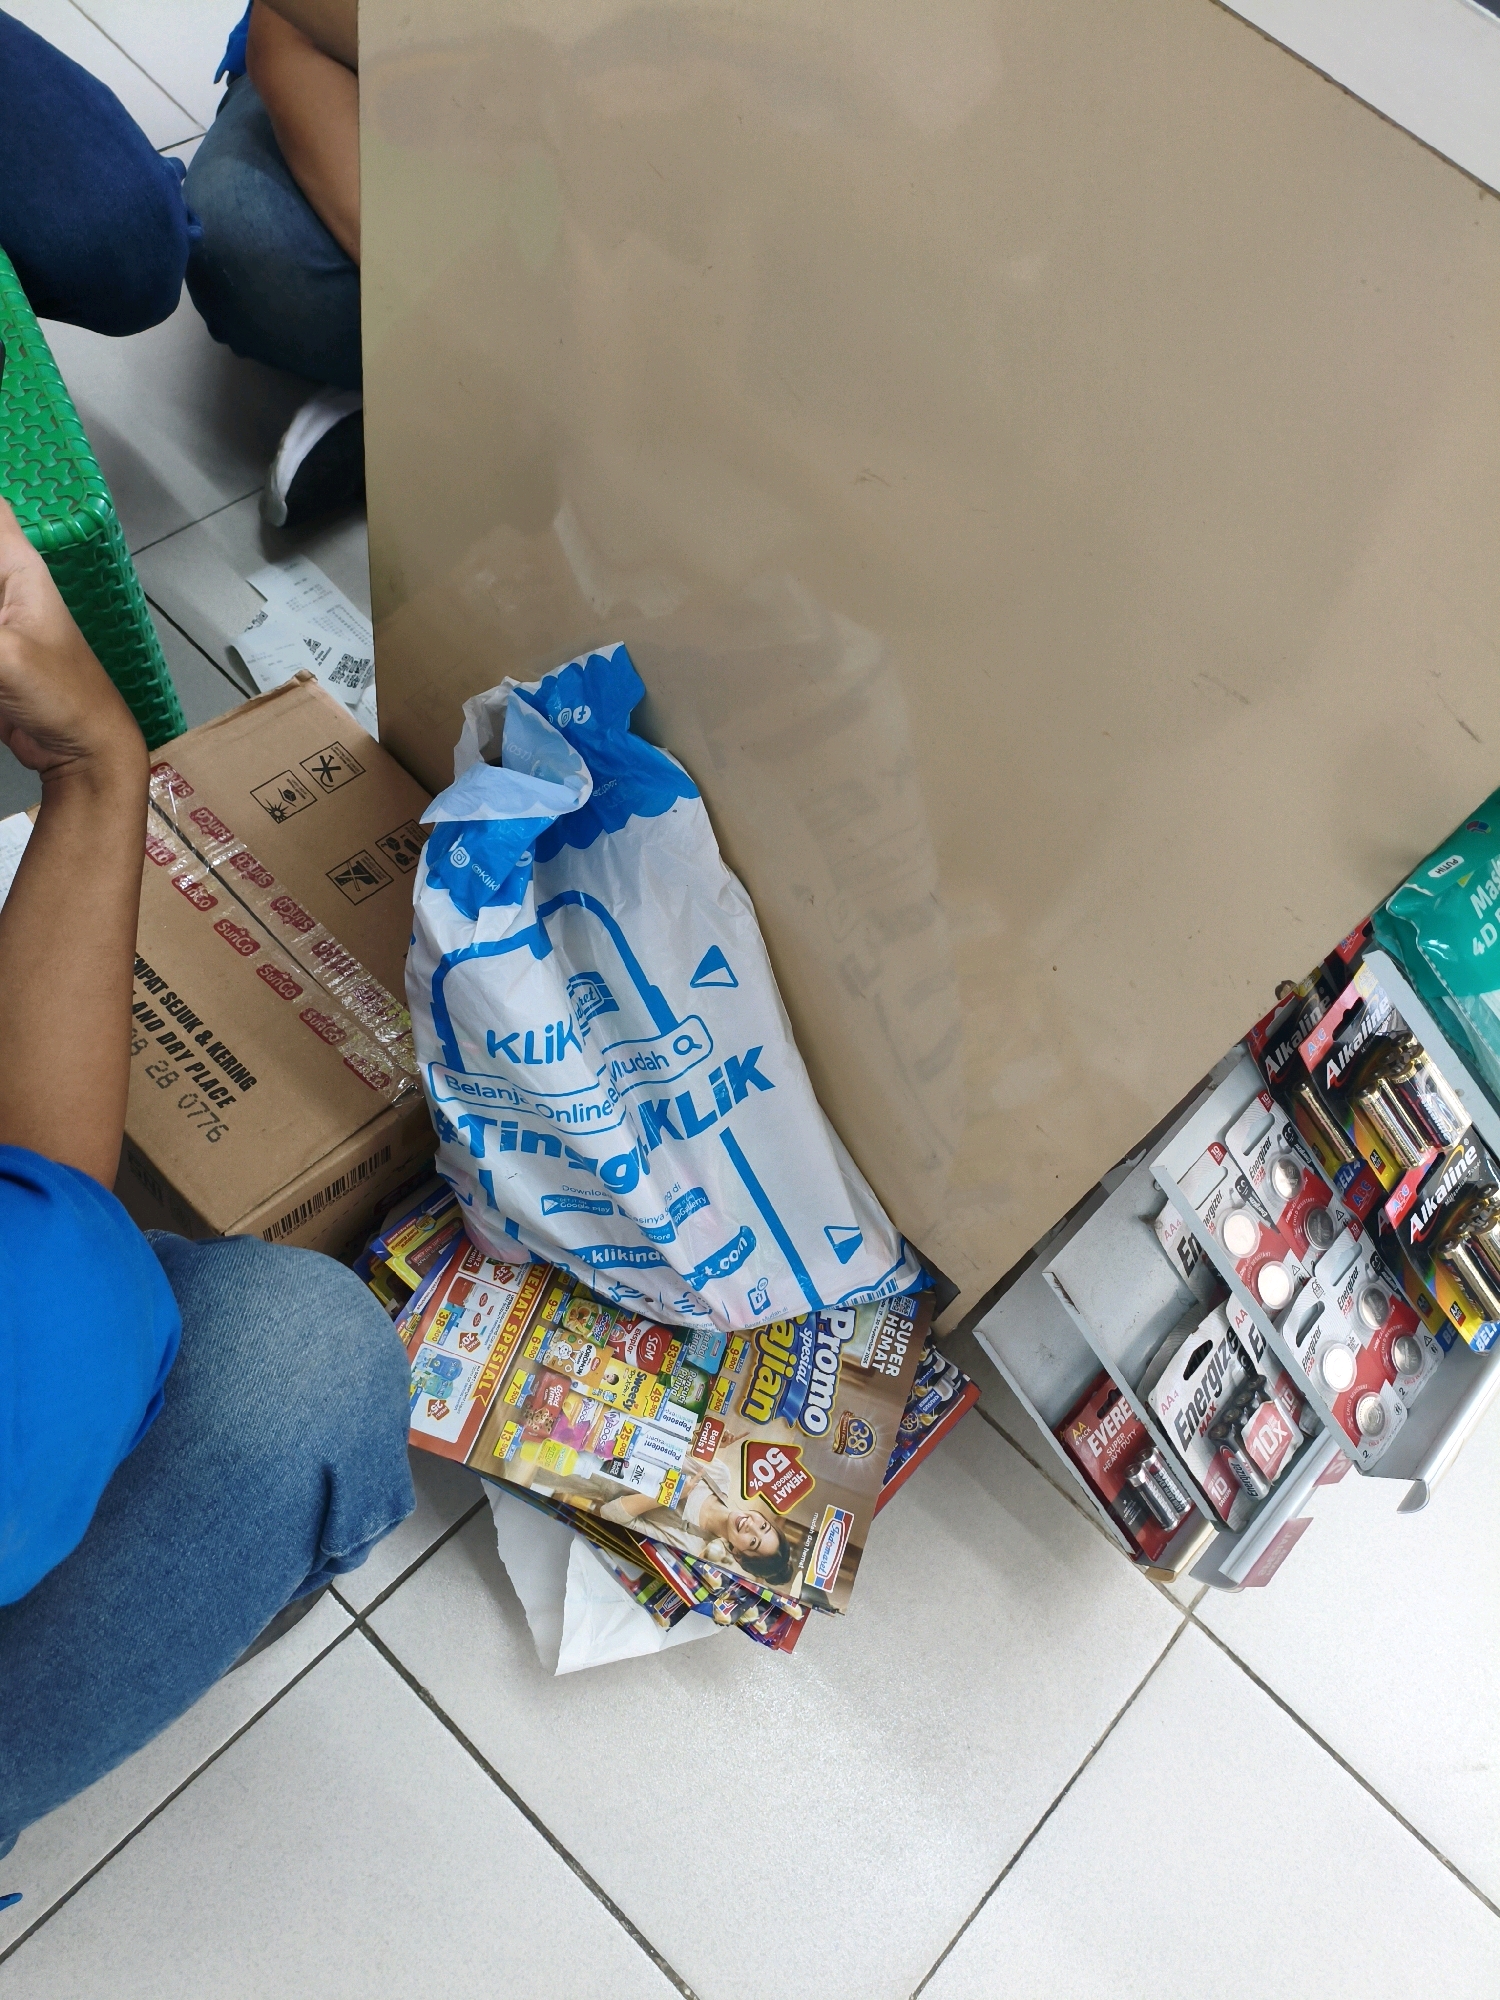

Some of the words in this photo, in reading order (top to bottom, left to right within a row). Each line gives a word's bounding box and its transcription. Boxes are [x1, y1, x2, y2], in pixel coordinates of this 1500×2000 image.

[236, 855, 273, 886] SunCo
[1434, 858, 1459, 875] PUTIH
[277, 899, 313, 932] SunCo
[219, 921, 254, 952] SunCo
[1472, 922, 1498, 956] 4D
[259, 965, 297, 998] SunCo
[134, 951, 169, 995] MPAT
[159, 991, 204, 1034] SEJUK
[194, 1030, 214, 1047] &
[206, 1041, 258, 1092] KERING
[303, 1009, 341, 1043] SunCo
[1264, 995, 1332, 1084] Alkaline
[1306, 1028, 1327, 1057] ABC
[1326, 997, 1390, 1090] Alkaline
[156, 1031, 195, 1062] DRY
[184, 1062, 237, 1109] PLACE
[145, 1060, 179, 1090] 28
[177, 1093, 229, 1143] 0776
[535, 1101, 613, 1124] Online
[1261, 1093, 1269, 1102] 10
[1211, 1145, 1220, 1156] 10
[1249, 1136, 1271, 1179] Energizer
[1294, 1143, 1312, 1163] Energizer
[560, 1201, 590, 1211] Google
[1203, 1190, 1223, 1227] nergizer
[1249, 1197, 1267, 1218] Energizer
[1352, 1181, 1372, 1208] ABC
[1392, 1183, 1410, 1212] ABC
[1410, 1144, 1478, 1245] Alkaline
[512, 1264, 546, 1320] HEMAT
[1337, 1265, 1360, 1311] Energizer
[546, 1299, 558, 1320] 9.700
[432, 1311, 449, 1342] 38.400
[627, 1328, 642, 1354] Eksplor
[479, 1324, 518, 1390] SPESIAL
[529, 1336, 540, 1359] 6.500
[645, 1335, 658, 1361] SGM
[666, 1343, 680, 1373] 83.000
[795, 1327, 813, 1386] spesial
[872, 1314, 899, 1373] HEMAT
[886, 1319, 913, 1377] SUPER
[1301, 1327, 1322, 1373] Energizer
[746, 1314, 808, 1422] ajian
[803, 1309, 856, 1433] Promo
[510, 1382, 523, 1403] 7.500
[547, 1386, 557, 1406] Time
[553, 1384, 563, 1407] Good
[623, 1371, 647, 1412] Sweety
[679, 1370, 699, 1405] Pencuci
[1174, 1325, 1240, 1452] Energize
[1399, 1387, 1406, 1396] 2
[922, 1395, 940, 1412] KHUSUS
[698, 1422, 712, 1447] Gratis
[1072, 1421, 1087, 1440] AA
[1078, 1426, 1092, 1442] PACK
[1087, 1396, 1134, 1458] EVERE
[1199, 1401, 1217, 1438] MAX
[499, 1430, 514, 1457] 13.900
[618, 1425, 633, 1457] 25.000
[644, 1440, 682, 1461] Pepsodent
[709, 1429, 719, 1446] Beli
[848, 1422, 870, 1452] 38
[1102, 1447, 1122, 1473] HEAVY
[1120, 1429, 1137, 1451] DUTY
[1106, 1432, 1126, 1456] SUPER
[749, 1447, 791, 1491] 50%
[1362, 1449, 1370, 1459] 2
[631, 1464, 645, 1485] ZINC
[771, 1468, 796, 1490] HINGGA
[772, 1470, 808, 1505] HEMAT
[1211, 1476, 1229, 1499] 10
[1231, 1462, 1258, 1498] Energizer
[809, 1512, 819, 1534] mudah
[797, 1545, 810, 1569] hemat
[818, 1521, 840, 1574] Indomaret
